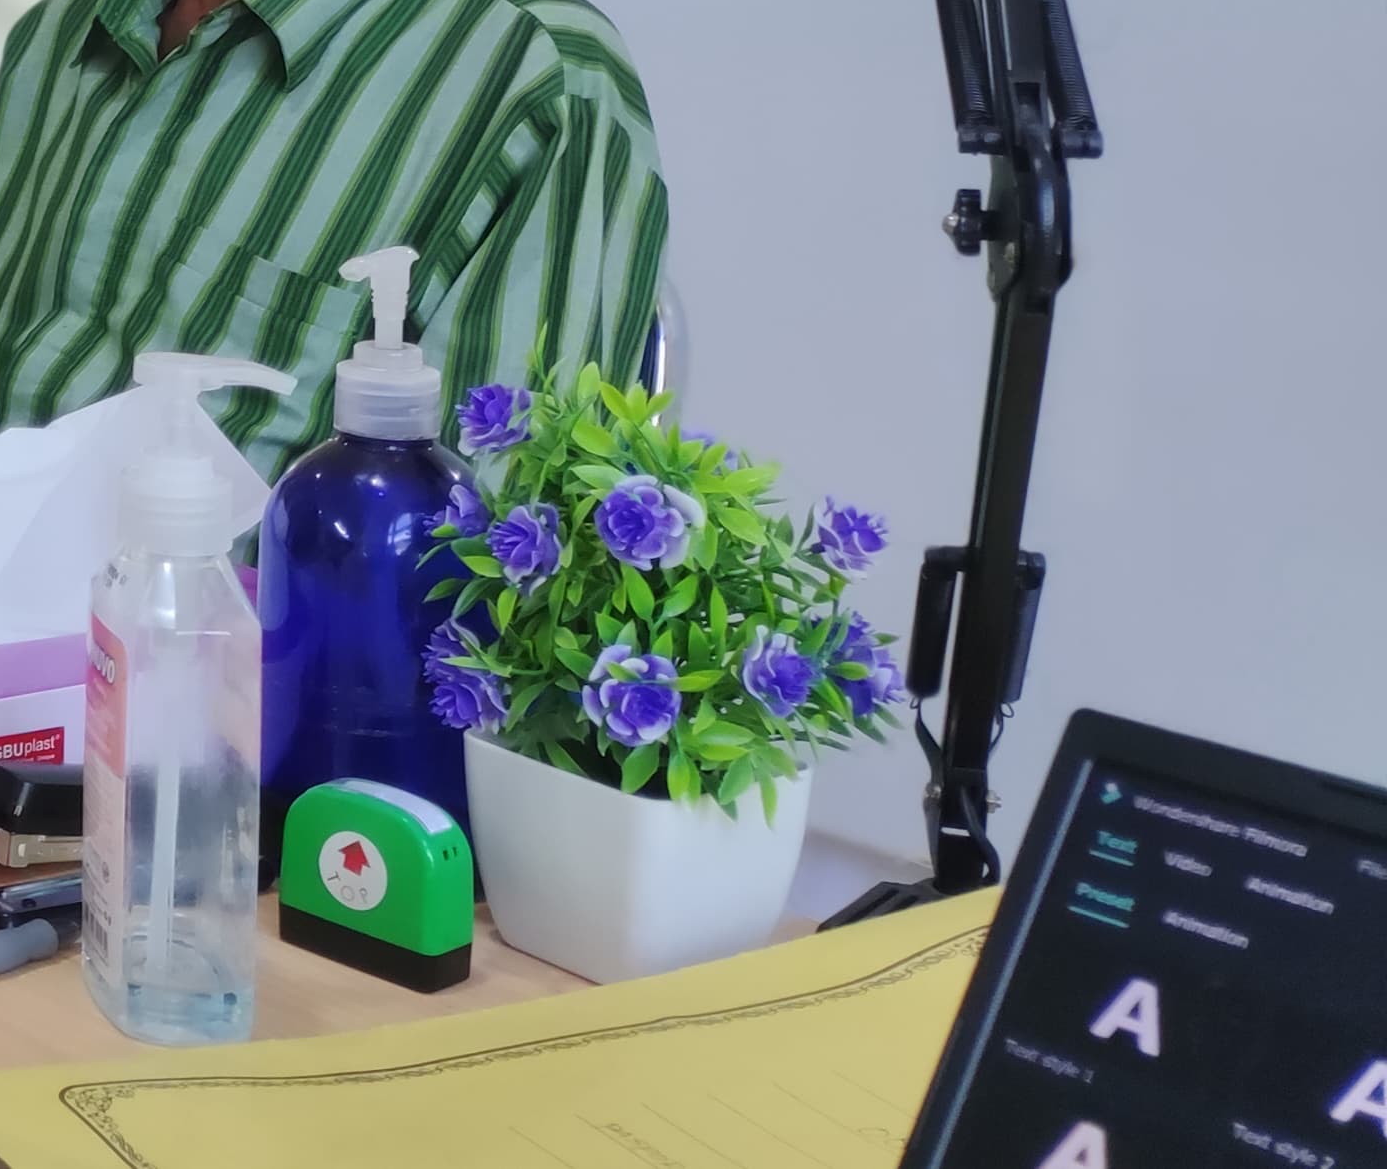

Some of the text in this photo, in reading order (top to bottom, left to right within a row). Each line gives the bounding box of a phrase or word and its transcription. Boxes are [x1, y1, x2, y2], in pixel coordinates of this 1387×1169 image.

[1133, 794, 1240, 838] Wondershare
[1243, 826, 1308, 857] Filmora
[327, 870, 369, 905] TOP
[1097, 830, 1335, 915] Text Video Animation
[1075, 881, 1249, 949] Preset Animation
[1089, 978, 1160, 1058] A
[1329, 1059, 1387, 1140] A
[1035, 1120, 1108, 1169] A
[1233, 1122, 1273, 1151] Text
